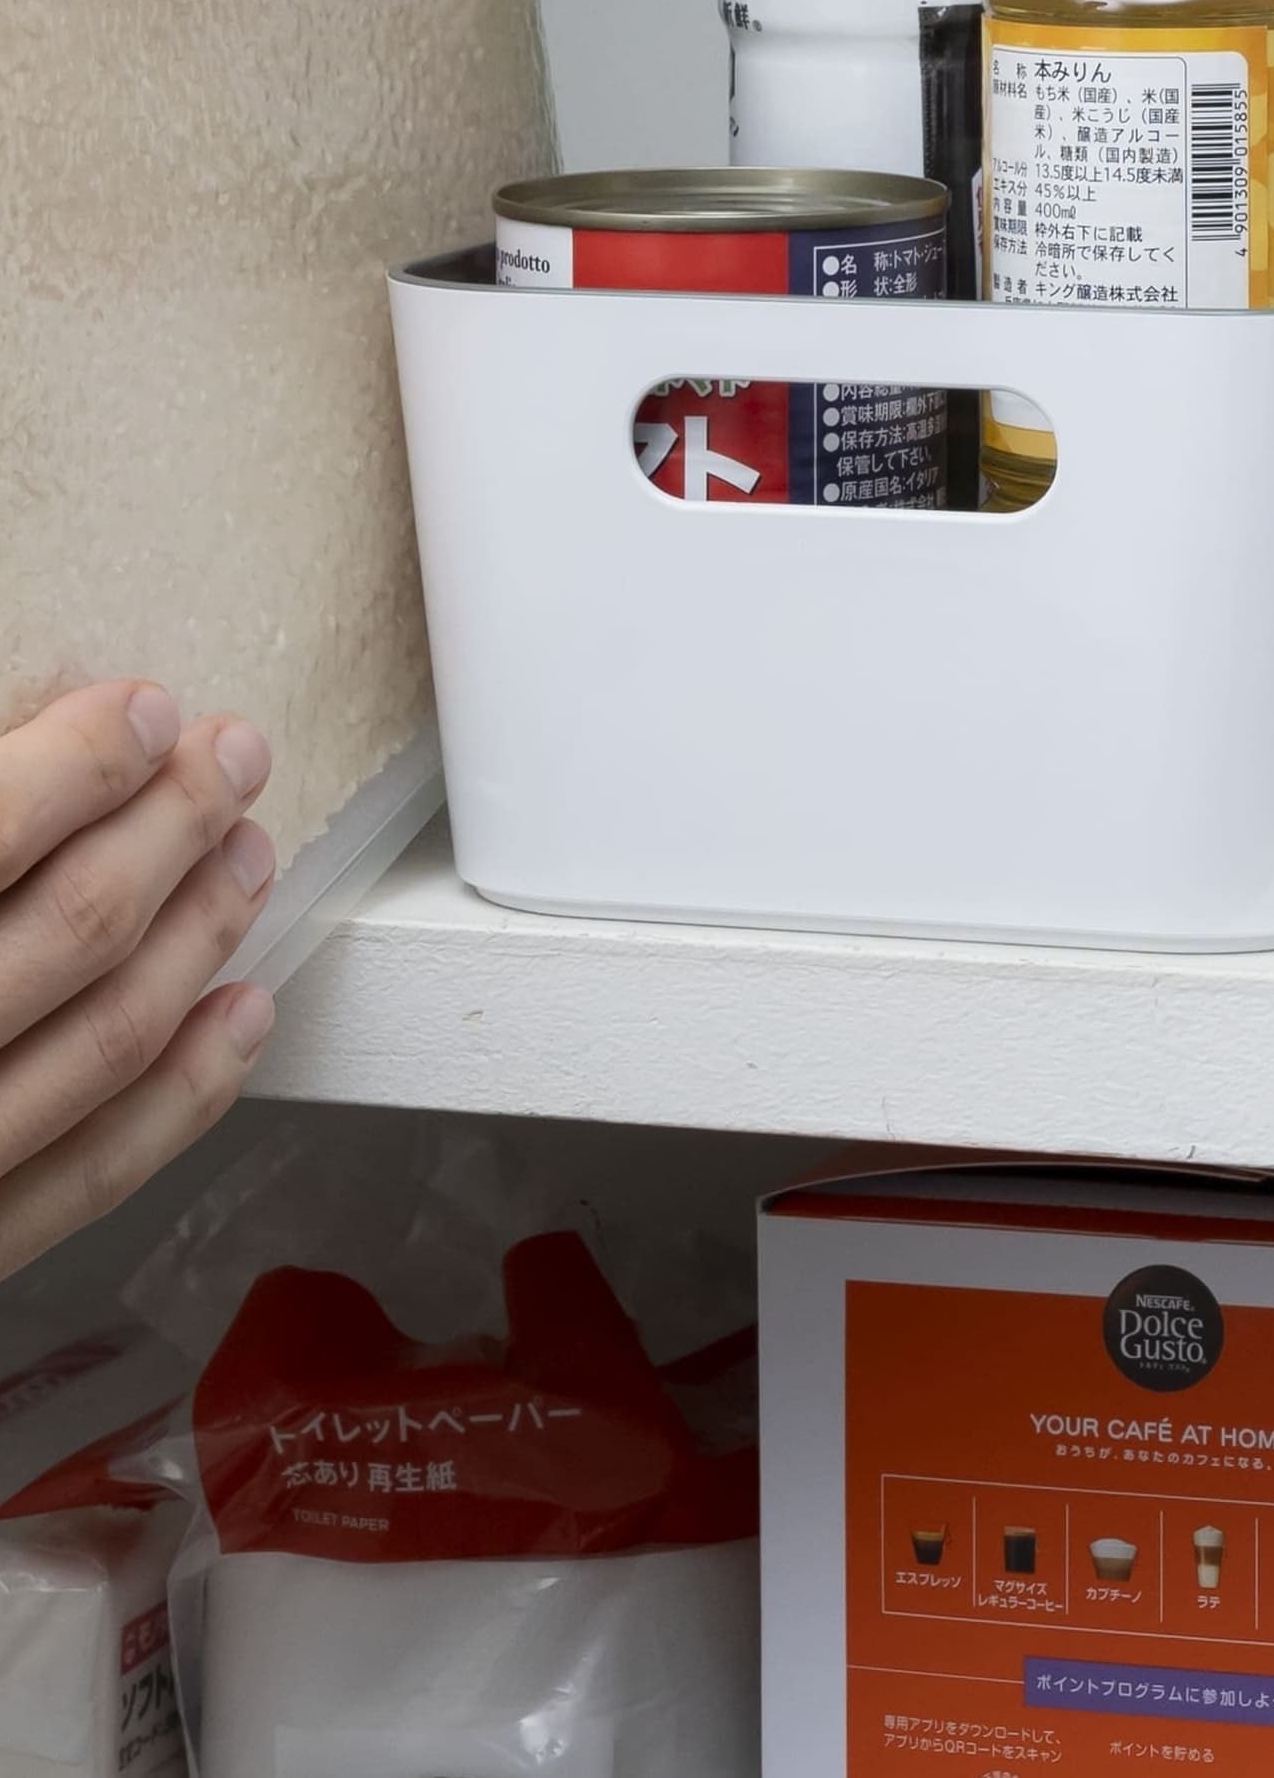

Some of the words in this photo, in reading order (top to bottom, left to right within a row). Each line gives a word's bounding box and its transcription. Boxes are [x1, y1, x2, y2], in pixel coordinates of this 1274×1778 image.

[1034, 58, 1113, 84] 本みりん
[1234, 89, 1248, 158] 015855
[1035, 162, 1184, 184] 13.5度以上14.5度未満
[1234, 166, 1248, 235] 901309
[1034, 222, 1144, 243] 枠外右下に記載
[1034, 240, 1176, 263] 冷暗所で保存してく
[1234, 246, 1248, 258] 4
[1034, 261, 1084, 281] ださい。
[1034, 281, 1180, 303] キング醸造株式会社
[1118, 1308, 1205, 1340] Dolce
[1119, 1334, 1205, 1364] Gusto
[269, 1395, 582, 1455] トイレットペーパー
[1029, 1412, 1100, 1439] YOUR
[1106, 1417, 1174, 1444] CAFÉ
[1180, 1424, 1213, 1446] AT
[366, 1459, 458, 1495] 再生紙
[291, 1507, 339, 1527] TOILET
[340, 1511, 390, 1532] PAPER
[894, 1570, 963, 1590] エスプレッソ
[993, 1578, 1048, 1596] マグサイズ
[978, 1594, 1064, 1613] レギュラーコーヒー
[1084, 1586, 1143, 1605] カプチーノ
[1196, 1594, 1221, 1610] ラテ
[883, 1713, 1063, 1747] 専用アプリをダウンロードして、
[883, 1732, 1064, 1765] アプリからQRコードをスキャン
[1108, 1739, 1216, 1765] ポイントを貯める
